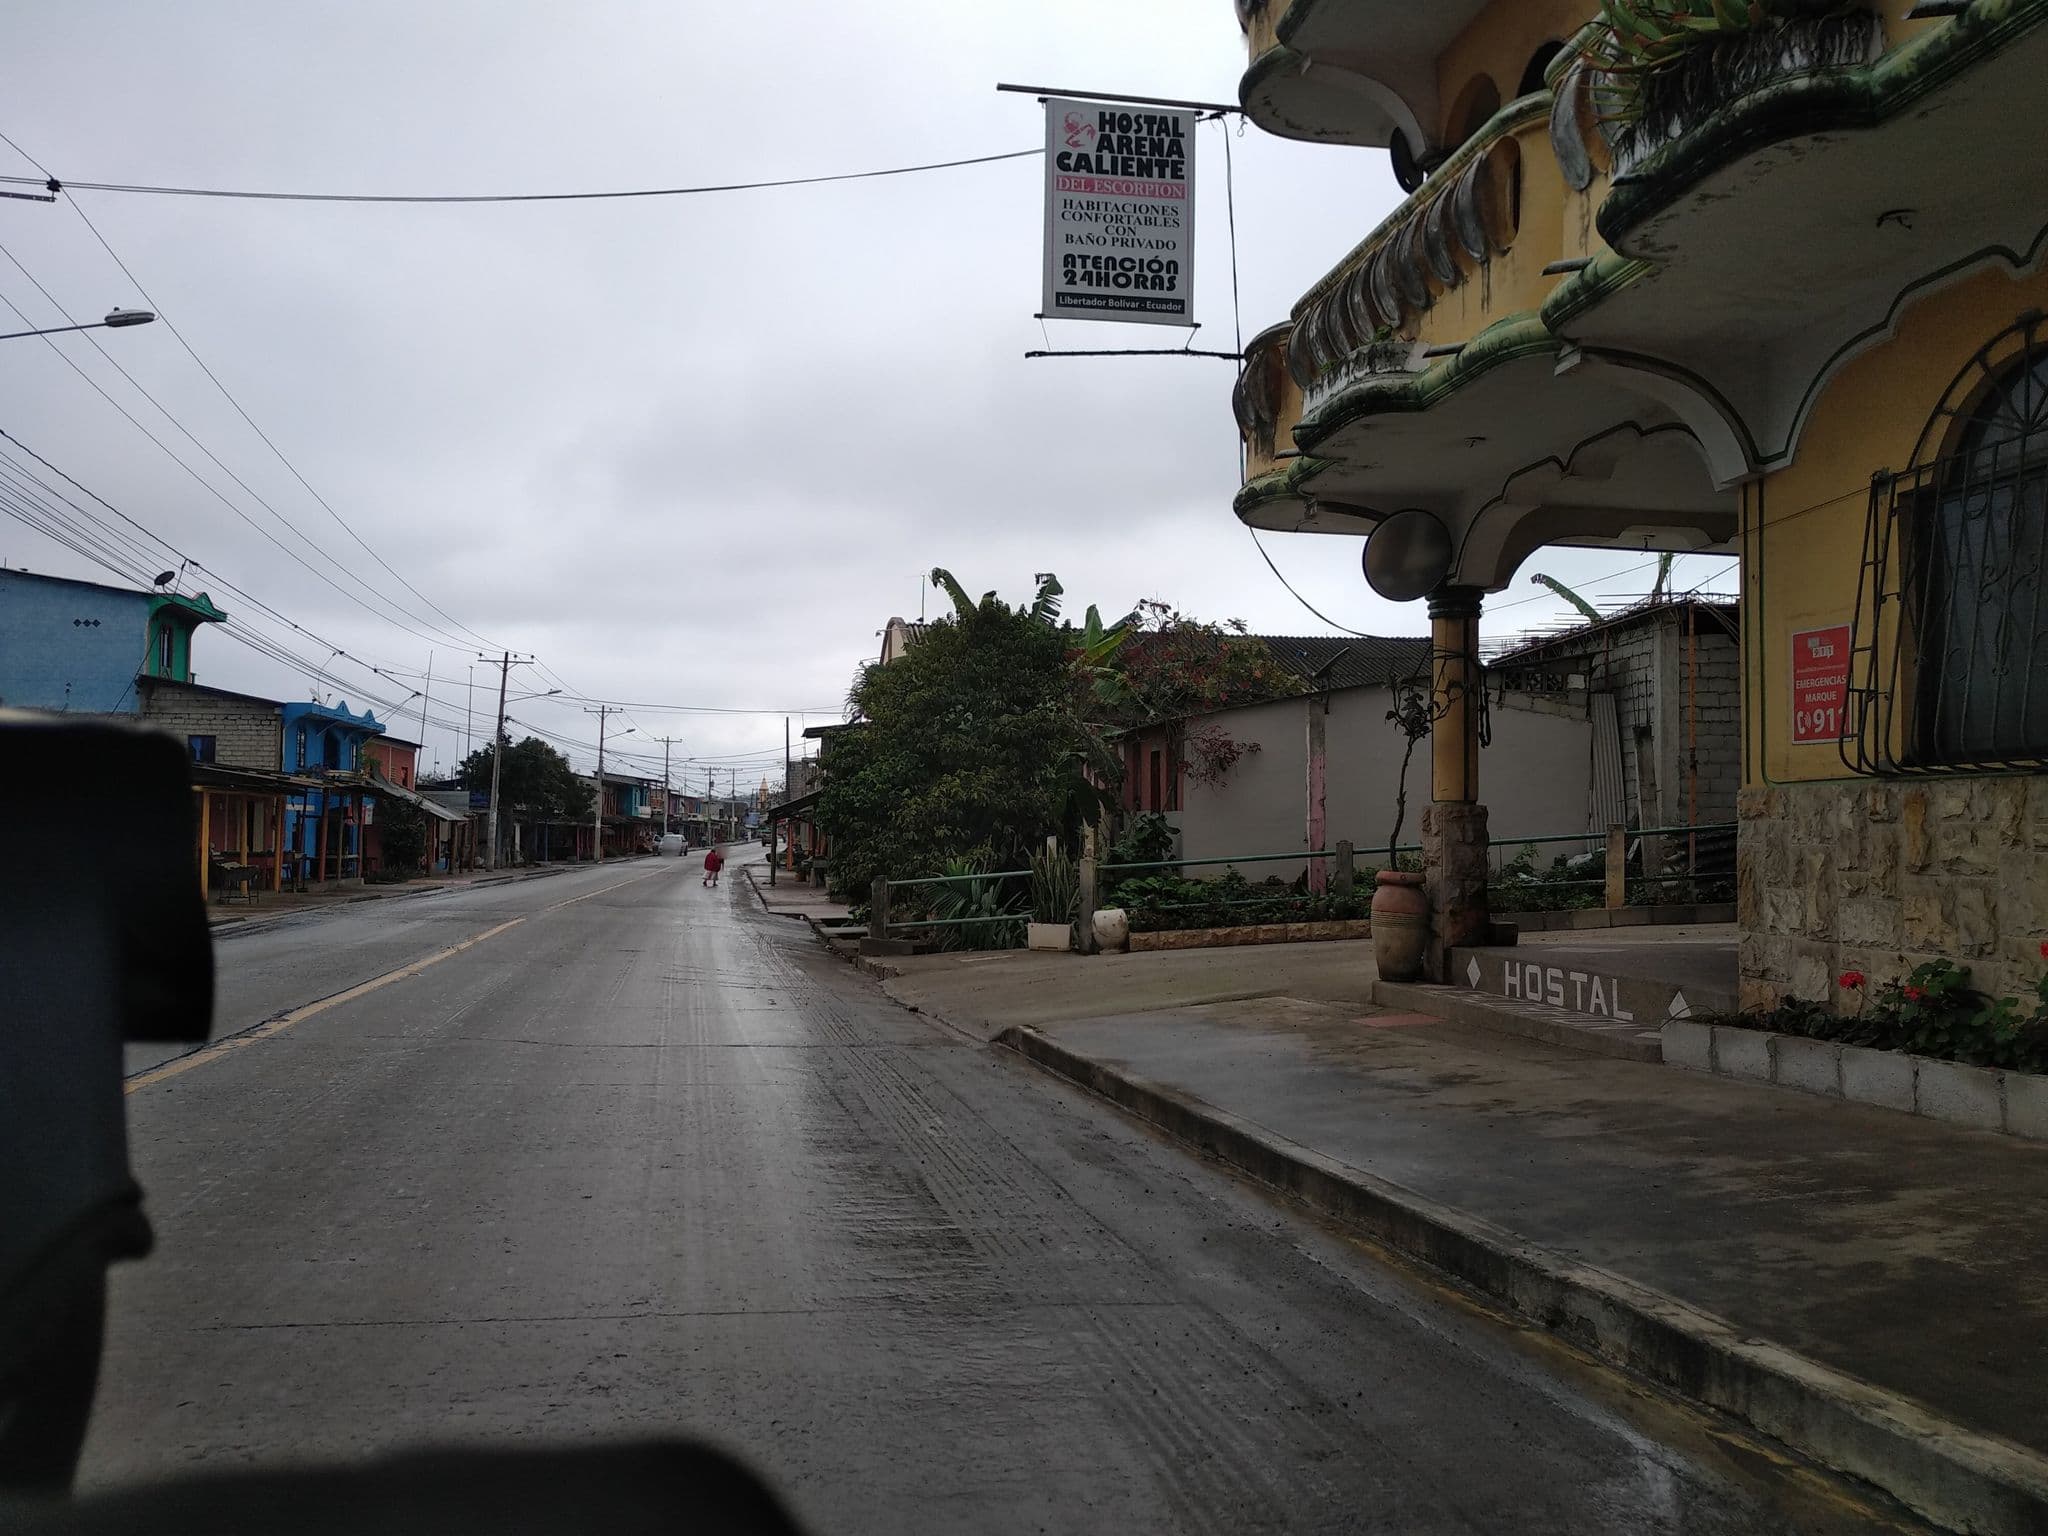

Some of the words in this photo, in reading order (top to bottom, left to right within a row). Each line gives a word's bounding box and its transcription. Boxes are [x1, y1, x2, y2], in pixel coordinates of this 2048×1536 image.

[1099, 112, 1185, 138] HOSTAL
[1096, 134, 1185, 158] ARENA
[1056, 152, 1185, 179] CALIENTE
[1058, 177, 1089, 191] DEL
[1063, 199, 1179, 216] HABITACIONES
[1061, 211, 1180, 228] CONFORTABLES
[1105, 225, 1136, 236] CON
[1065, 233, 1107, 246] BAÑO
[1111, 238, 1176, 250] PRIVADO
[1063, 254, 1179, 275] ATENCIÓN
[1064, 270, 1176, 291] 24HORAS
[1060, 296, 1107, 307] Libertador
[1146, 300, 1182, 311] Ecuador
[1796, 675, 1846, 689] EMERGENCIAS
[1806, 691, 1837, 702] MARQUE
[1504, 961, 1633, 1021] HOSTAL
